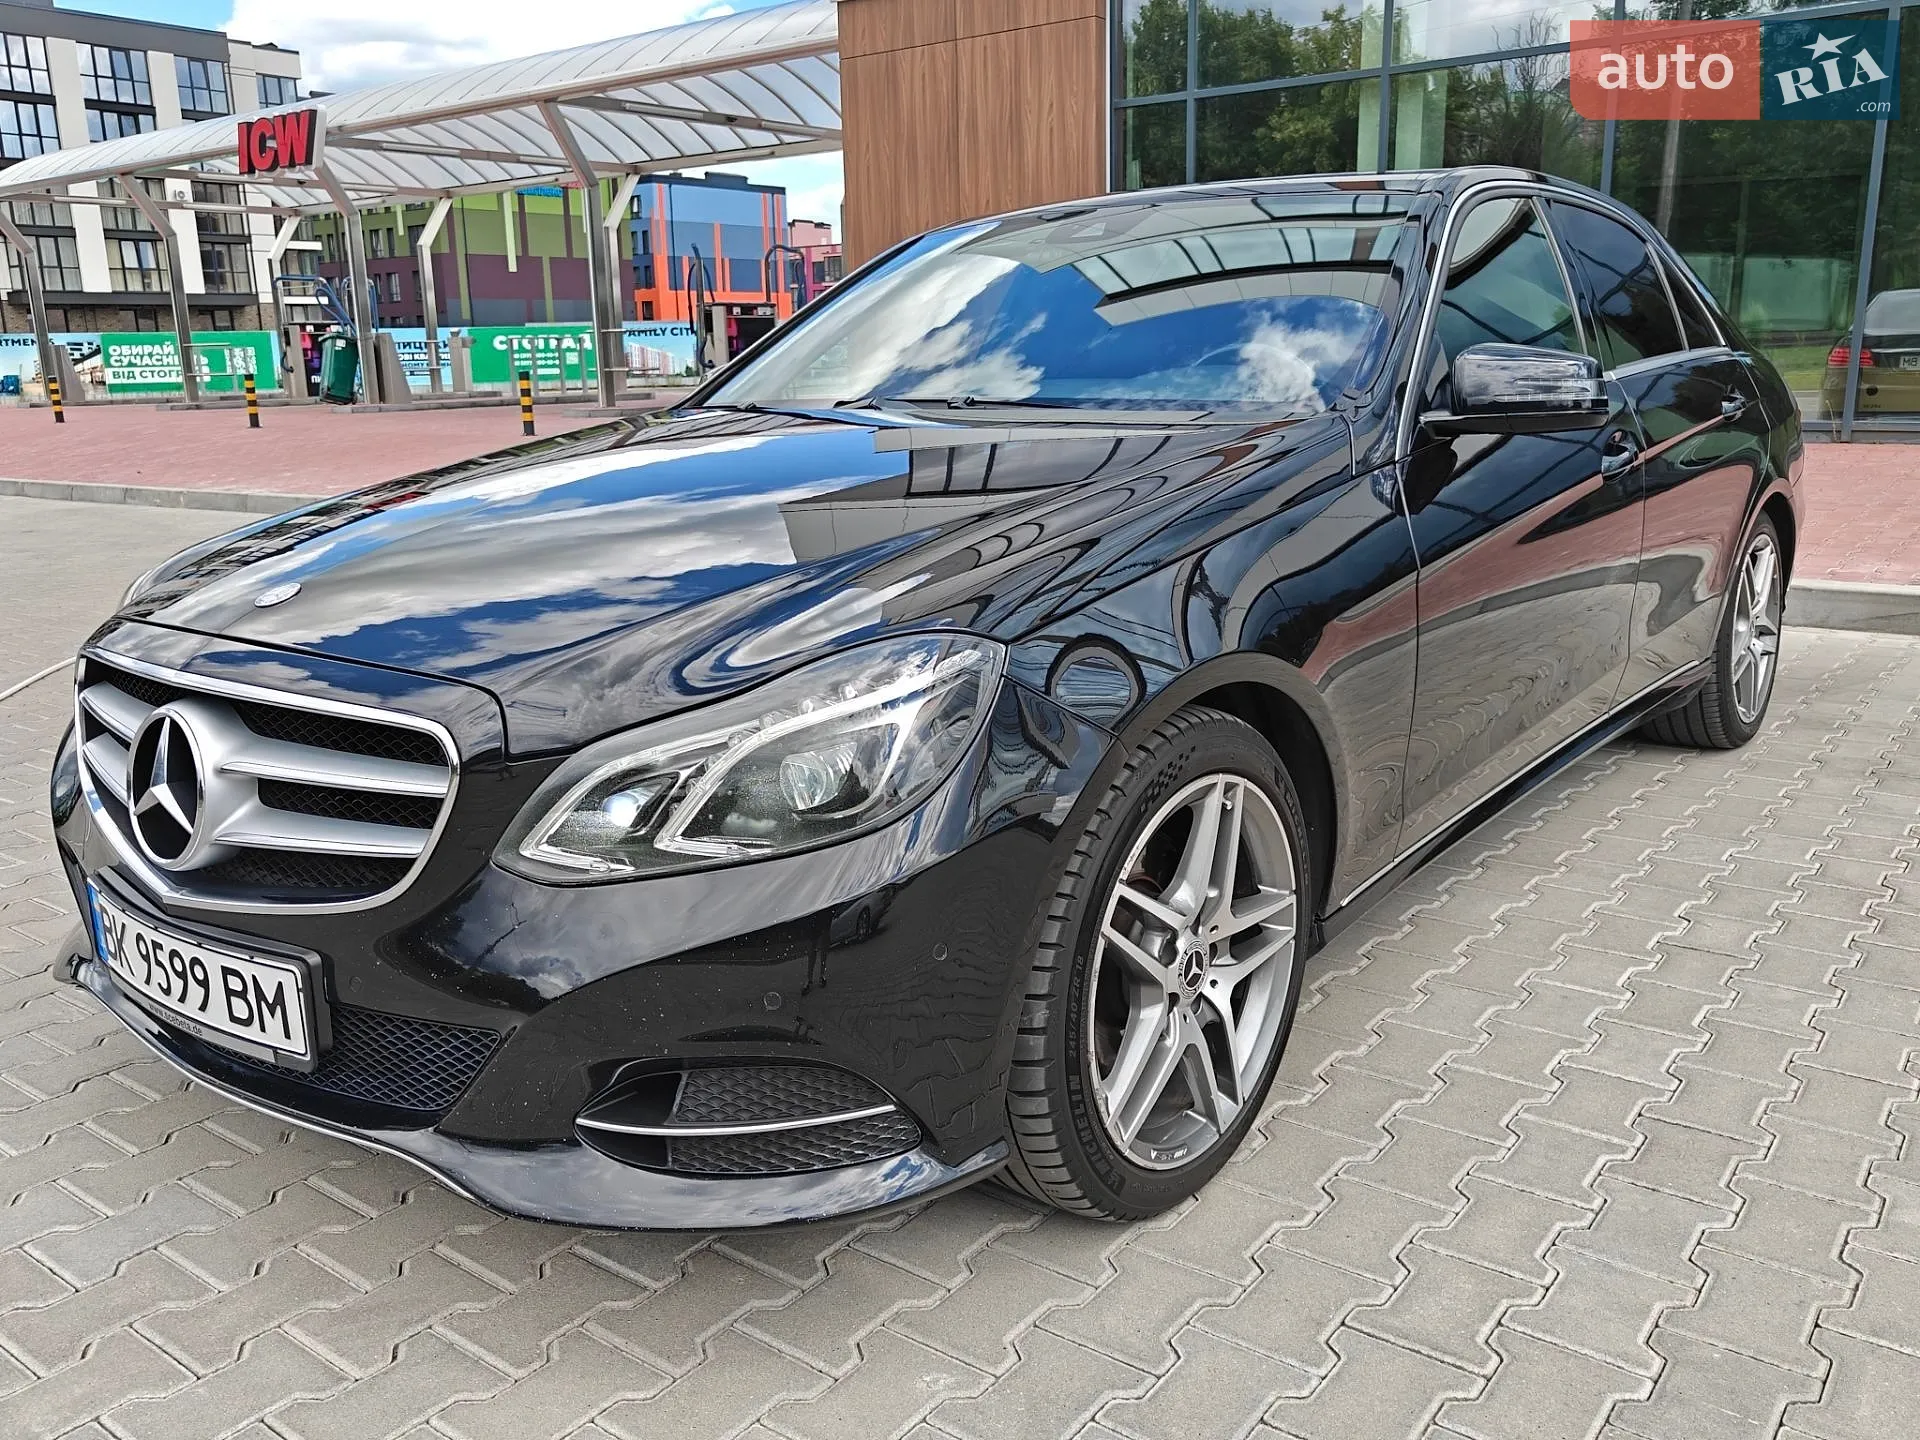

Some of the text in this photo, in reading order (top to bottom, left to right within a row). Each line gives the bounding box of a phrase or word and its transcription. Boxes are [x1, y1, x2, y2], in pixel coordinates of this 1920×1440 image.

[238, 109, 317, 175] ICW
[670, 327, 697, 337] CIT
[108, 341, 175, 356] ОБИРАЙ
[112, 370, 136, 380] ВІД
[100, 903, 291, 1041] BK 9599 BM
